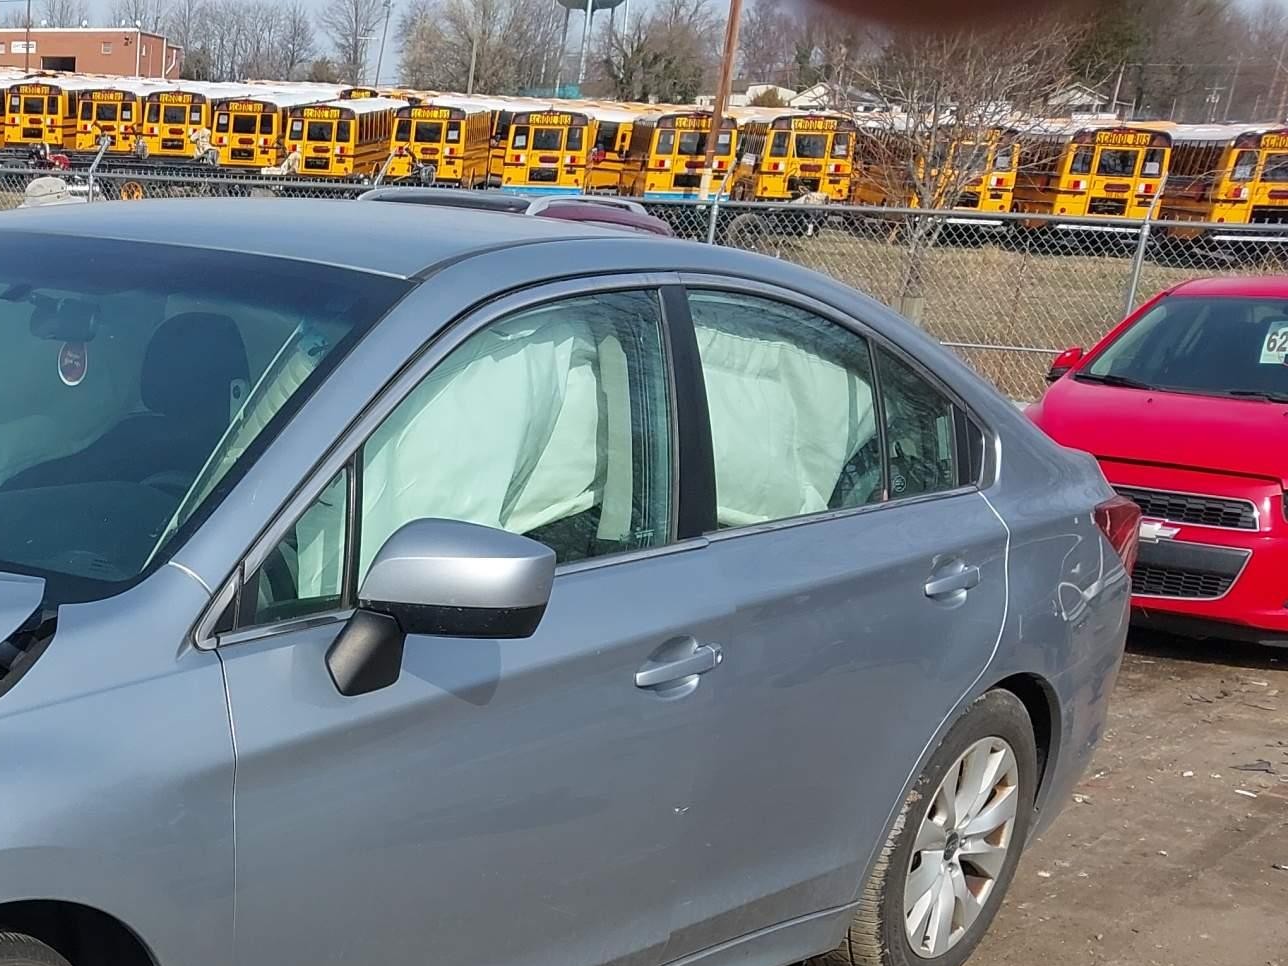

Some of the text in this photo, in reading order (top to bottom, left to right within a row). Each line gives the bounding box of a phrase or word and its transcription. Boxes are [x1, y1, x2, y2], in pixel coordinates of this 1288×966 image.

[530, 115, 570, 124] SCHOOL BUS
[793, 120, 836, 130] SCHOOL BUS
[1098, 133, 1150, 145] SCHOOL BUS
